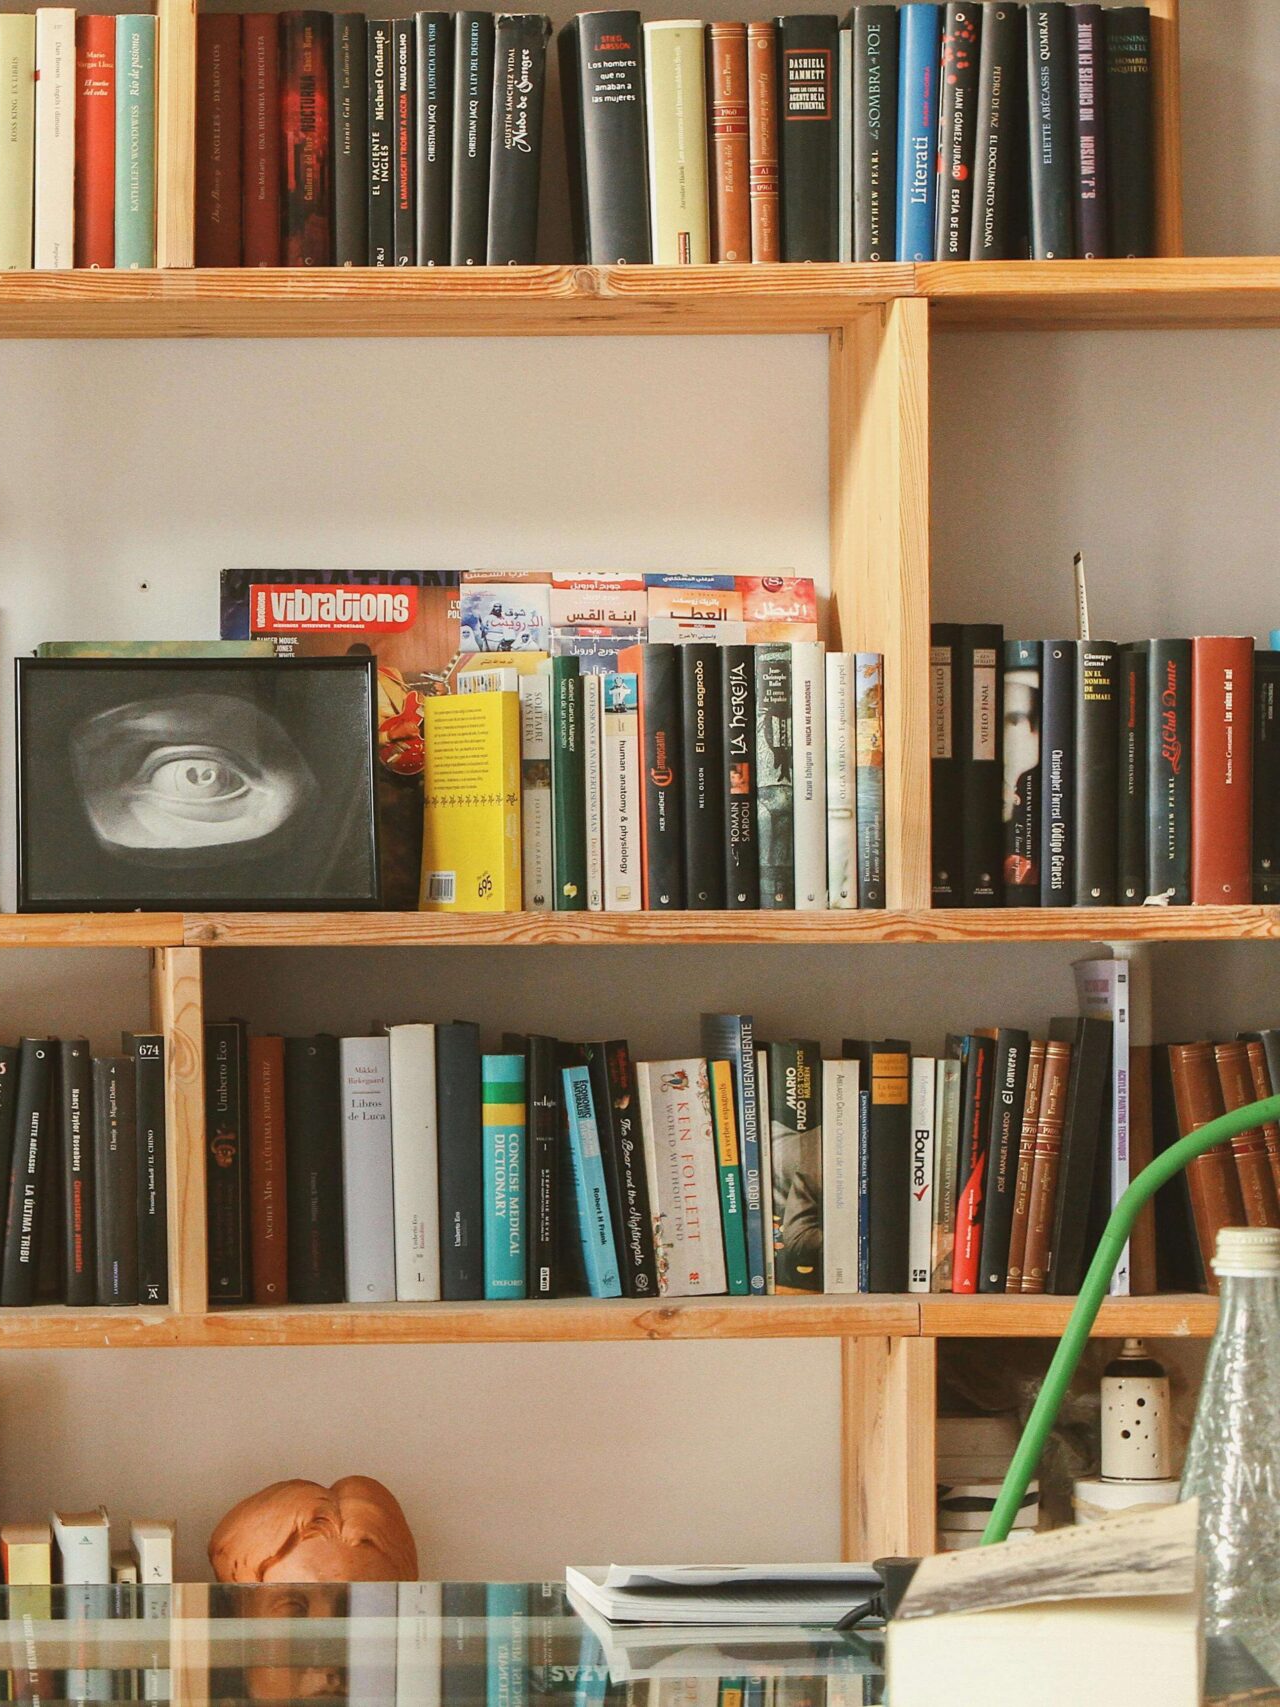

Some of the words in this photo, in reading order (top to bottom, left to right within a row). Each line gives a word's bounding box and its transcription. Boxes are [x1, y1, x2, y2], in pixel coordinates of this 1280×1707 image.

[374, 30, 390, 77] Ondaatje
[603, 60, 637, 68] hombres
[595, 83, 626, 91] amaban
[600, 72, 614, 80] que
[375, 79, 385, 120] Michael
[592, 94, 603, 103] las
[604, 94, 635, 103] mujeres
[372, 132, 380, 180] PACIENTE
[380, 145, 389, 182] INGLÉS
[871, 150, 879, 185] PEARL
[911, 136, 929, 204] Literati
[372, 185, 380, 195] EL
[871, 190, 879, 245] MATTHEW
[567, 609, 604, 622] القس
[608, 611, 636, 624] ابنة
[618, 740, 627, 772] human
[1051, 749, 1063, 791] Christopher
[618, 774, 627, 814] anatomy
[1051, 793, 1063, 819] Forrest
[731, 802, 740, 842] ROMAIN
[741, 802, 750, 842] SARDOU
[1050, 822, 1064, 853] Código
[619, 825, 629, 875] physiology
[1050, 855, 1064, 889] Génesis
[139, 1045, 160, 1056] 674
[1118, 1069, 1126, 1094] ACRYLIC
[677, 1102, 692, 1142] KEN
[1118, 1095, 1127, 1124] PAINTING
[620, 1119, 631, 1137] The
[1117, 1125, 1126, 1161] TECHNIQUES
[508, 1133, 519, 1193] CONCISE
[620, 1140, 634, 1168] Bear
[913, 1129, 929, 1186] Bounce
[25, 1184, 35, 1197] LA
[494, 1134, 506, 1218] DICTIONARY
[625, 1170, 634, 1188] and
[627, 1190, 636, 1204] the
[680, 1153, 701, 1243] FOLLETT
[21, 1199, 36, 1232] ÚLTIMA
[509, 1197, 520, 1256] MEDICAL
[19, 1235, 31, 1263] TRIBU
[628, 1206, 644, 1266] Nightingale
